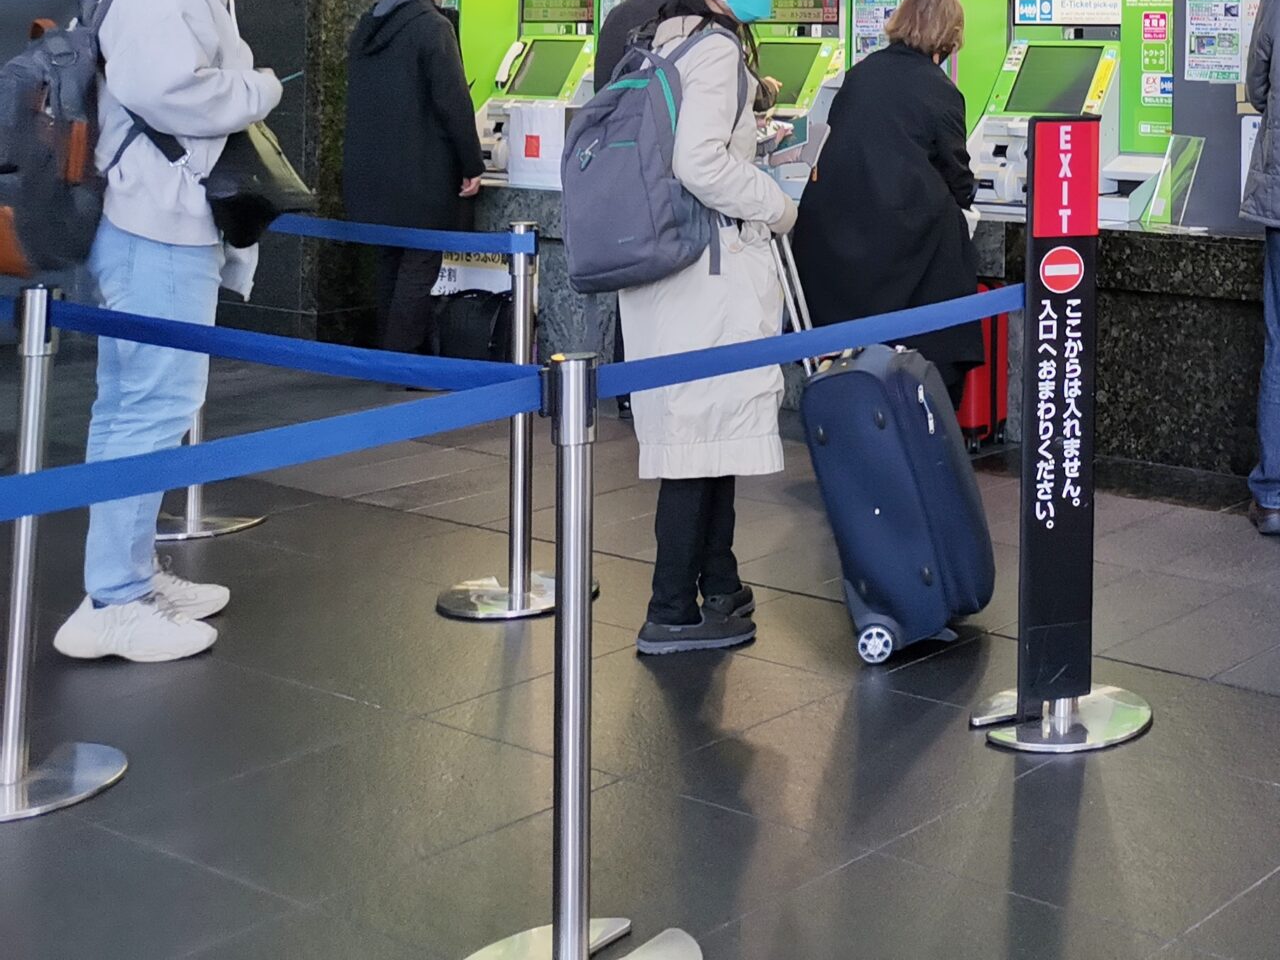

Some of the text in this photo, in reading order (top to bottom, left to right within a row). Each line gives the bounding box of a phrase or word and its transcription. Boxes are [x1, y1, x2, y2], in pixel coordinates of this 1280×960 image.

[1061, 0, 1118, 11] E-Ticket pick-up
[1146, 77, 1157, 85] EX
[1058, 125, 1072, 234] EXIT
[1035, 299, 1058, 530] 入口へおまわりください。
[1063, 298, 1083, 507] ここからは入れません。
